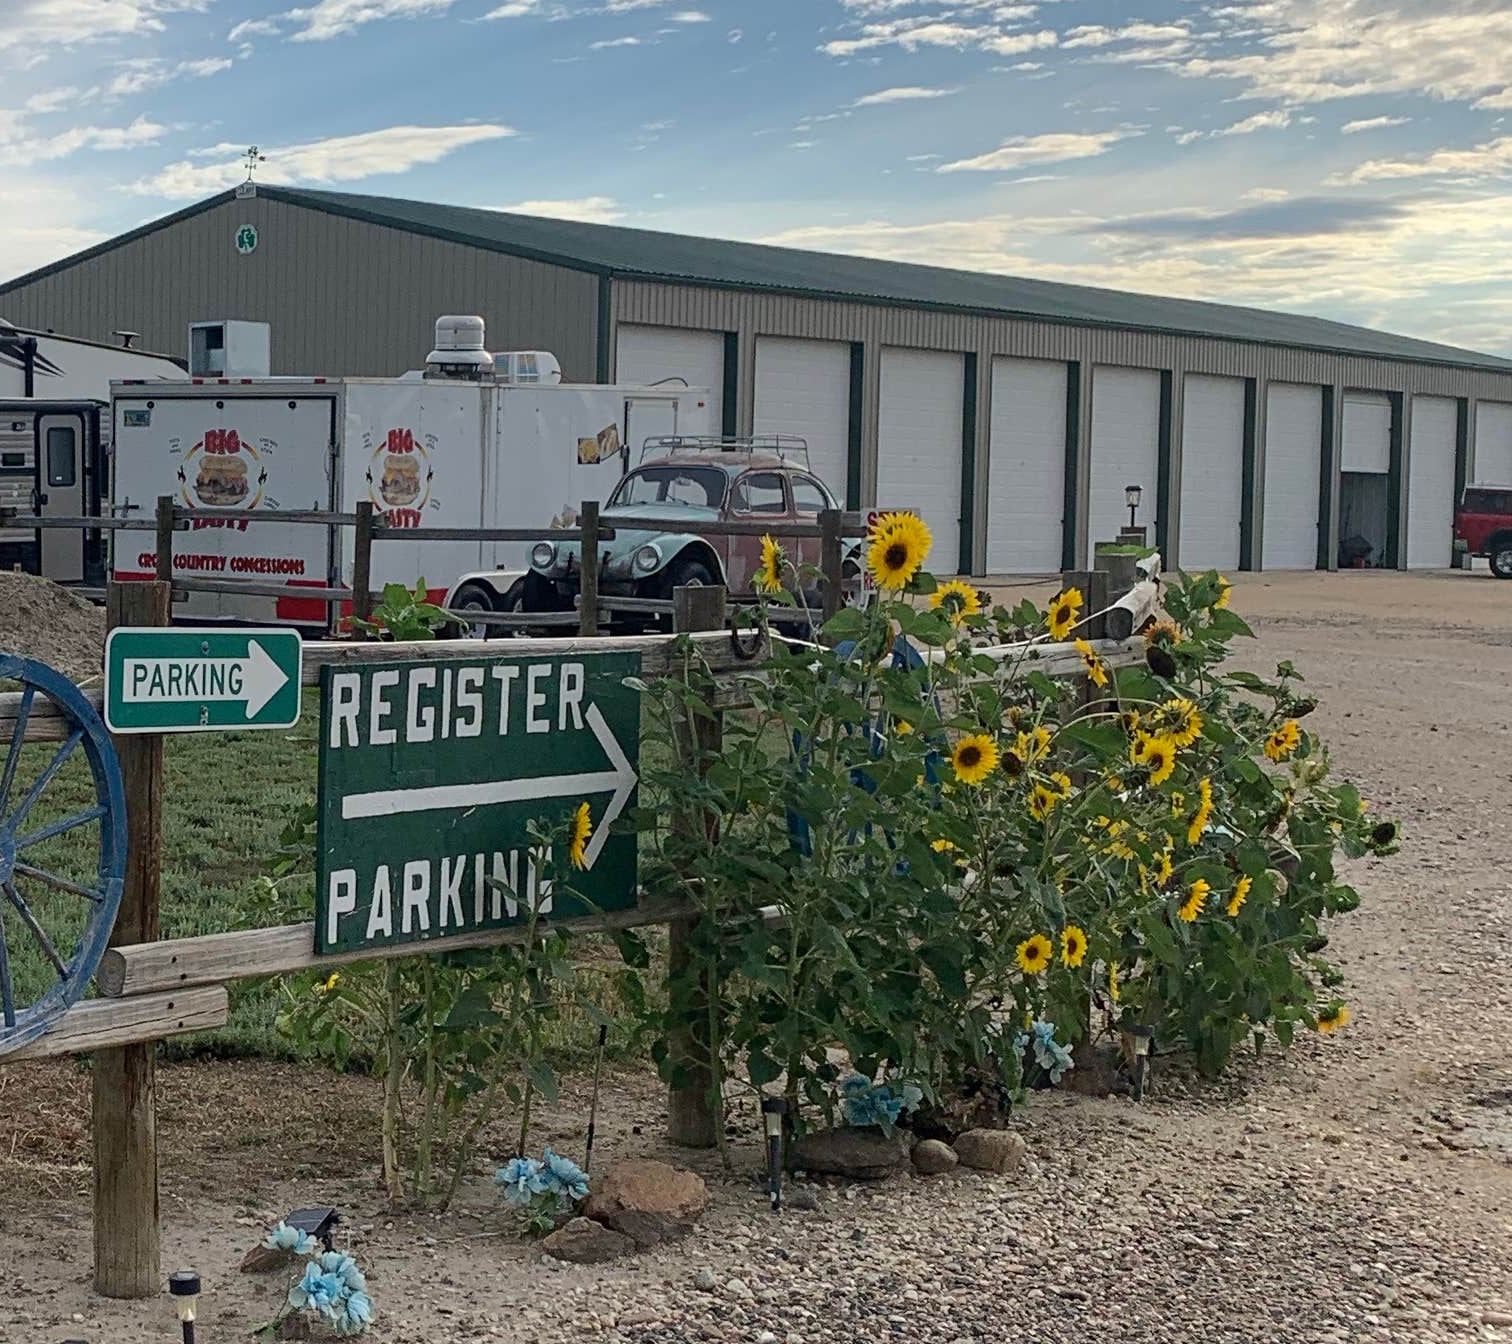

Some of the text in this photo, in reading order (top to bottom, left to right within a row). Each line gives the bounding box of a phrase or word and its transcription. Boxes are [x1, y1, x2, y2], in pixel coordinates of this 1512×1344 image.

[205, 429, 240, 455] BIG
[388, 428, 413, 454] BIG
[388, 508, 422, 528] ASTY
[173, 554, 227, 571] COUNTRY
[230, 556, 305, 575] CONCESSIONS
[133, 663, 243, 696] PARKING
[330, 662, 585, 749] REGISTER
[327, 846, 553, 945] PARKING
